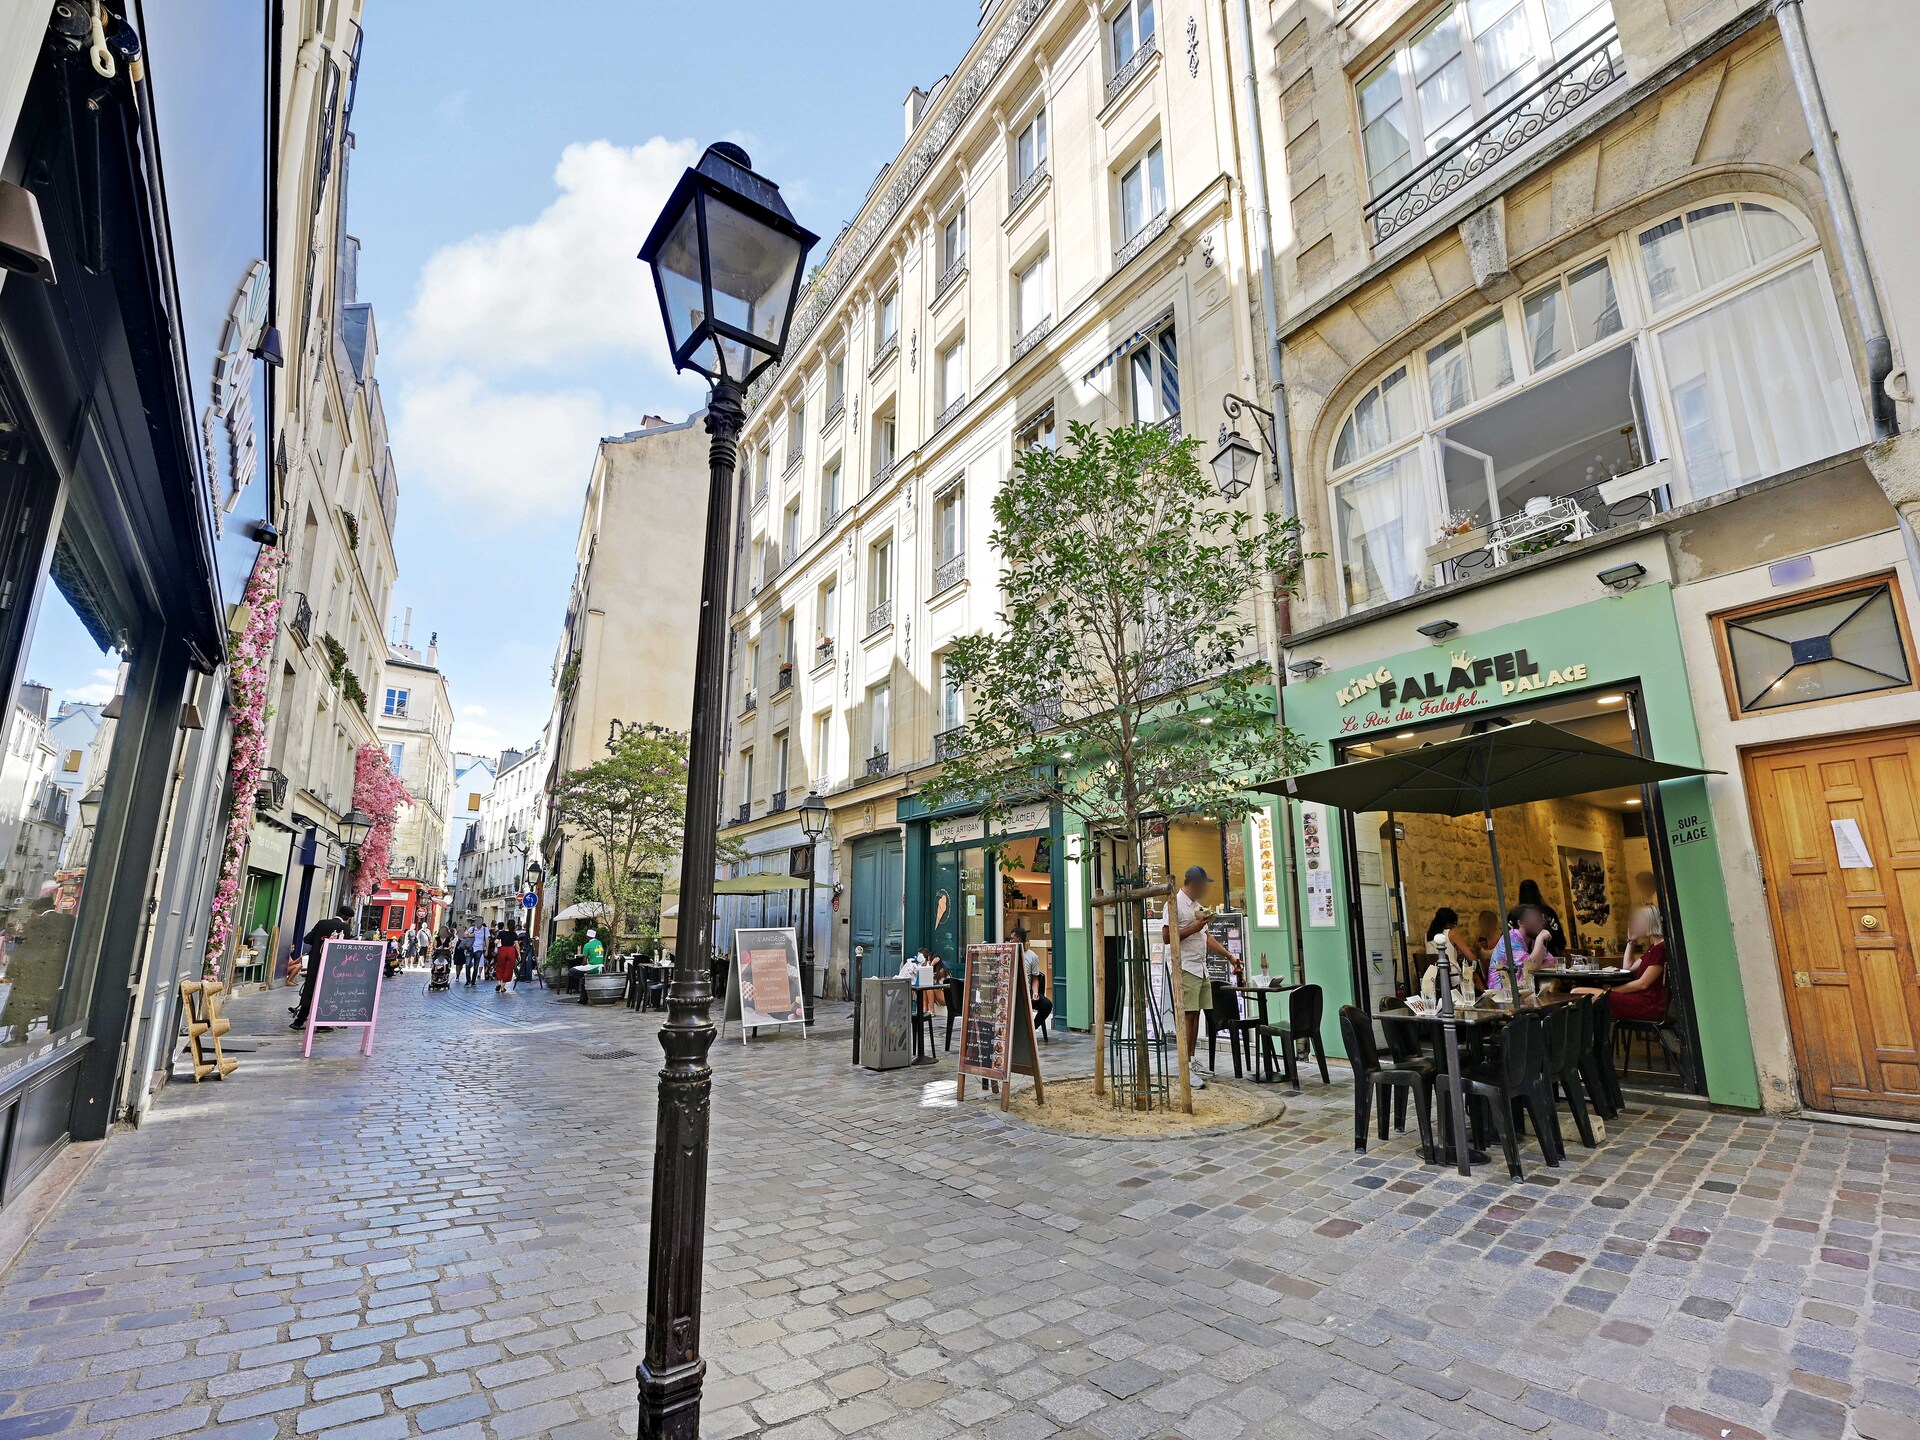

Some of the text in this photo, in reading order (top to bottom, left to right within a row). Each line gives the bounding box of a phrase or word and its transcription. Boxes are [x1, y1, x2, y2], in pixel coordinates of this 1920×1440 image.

[1379, 649, 1538, 708] FALAFEL
[1501, 663, 1588, 696] PALACE
[1340, 715, 1359, 734] Le
[1363, 710, 1390, 729] Roi
[1395, 707, 1414, 721] du
[1007, 811, 1036, 824] GLACIER
[1678, 815, 1698, 829] SUR
[956, 823, 979, 833] ARTISAN
[1672, 827, 1707, 845] PLACE
